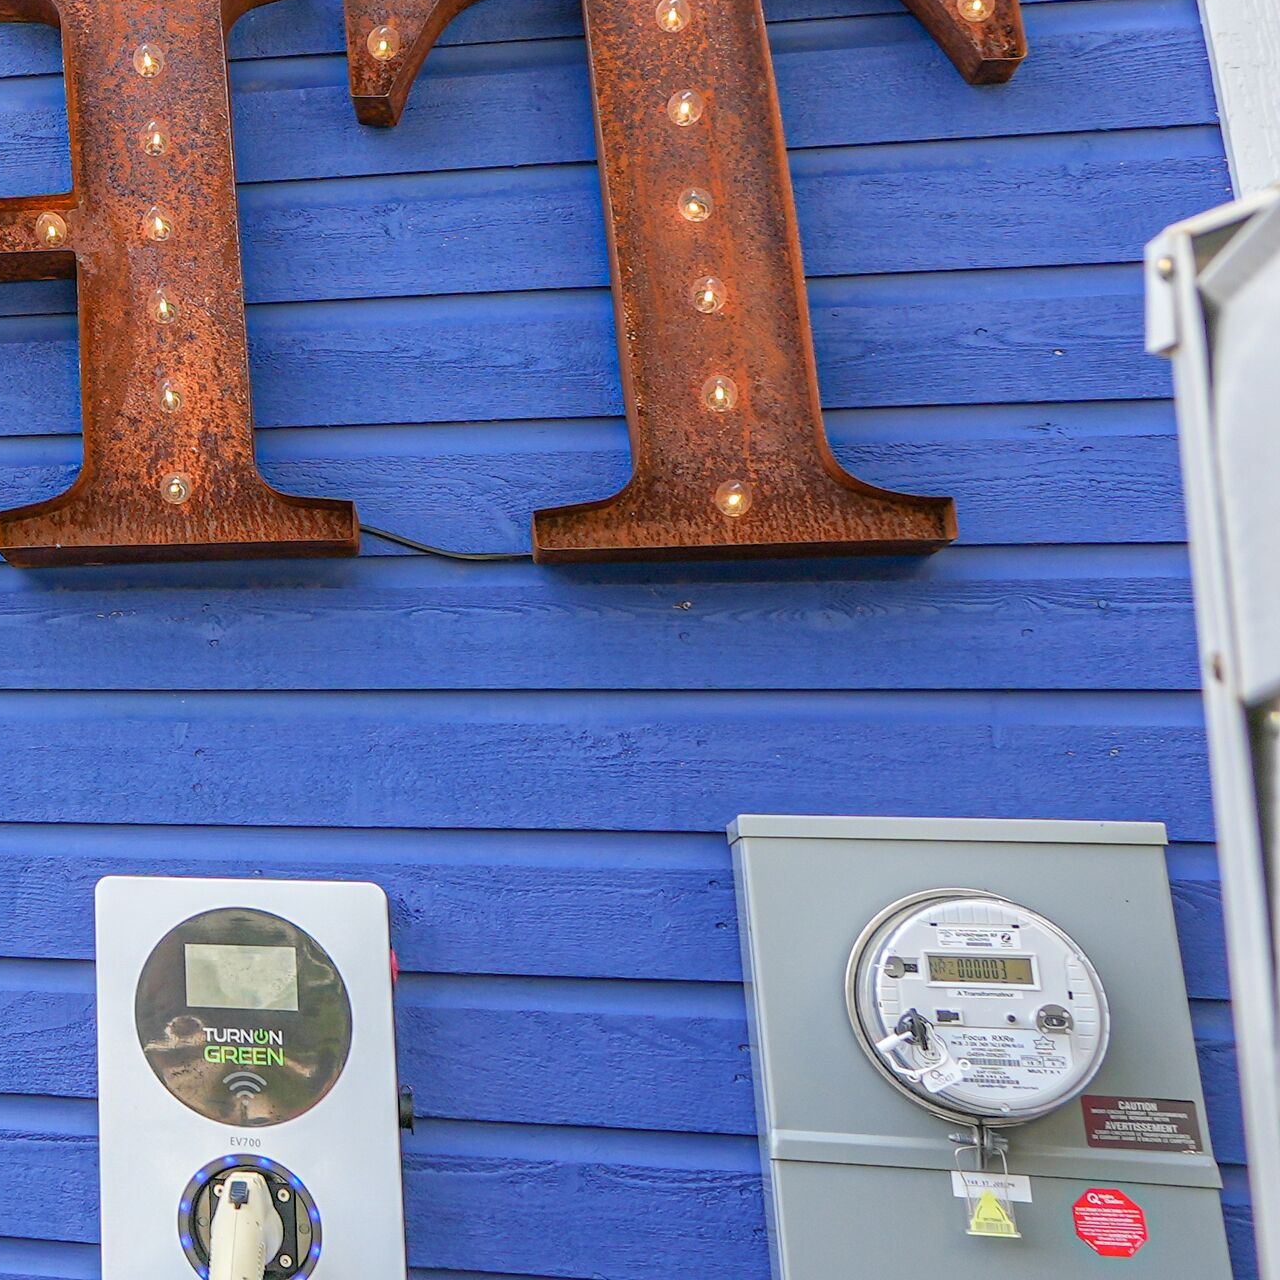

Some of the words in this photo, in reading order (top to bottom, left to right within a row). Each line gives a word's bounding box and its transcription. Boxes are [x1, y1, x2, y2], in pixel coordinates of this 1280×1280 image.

[202, 1027, 283, 1045] TURNON
[203, 1045, 285, 1066] GREEN
[1117, 1101, 1158, 1111] CAUTION
[1104, 1121, 1179, 1133] AVERTISSEMENT
[229, 1136, 261, 1148] EV700
